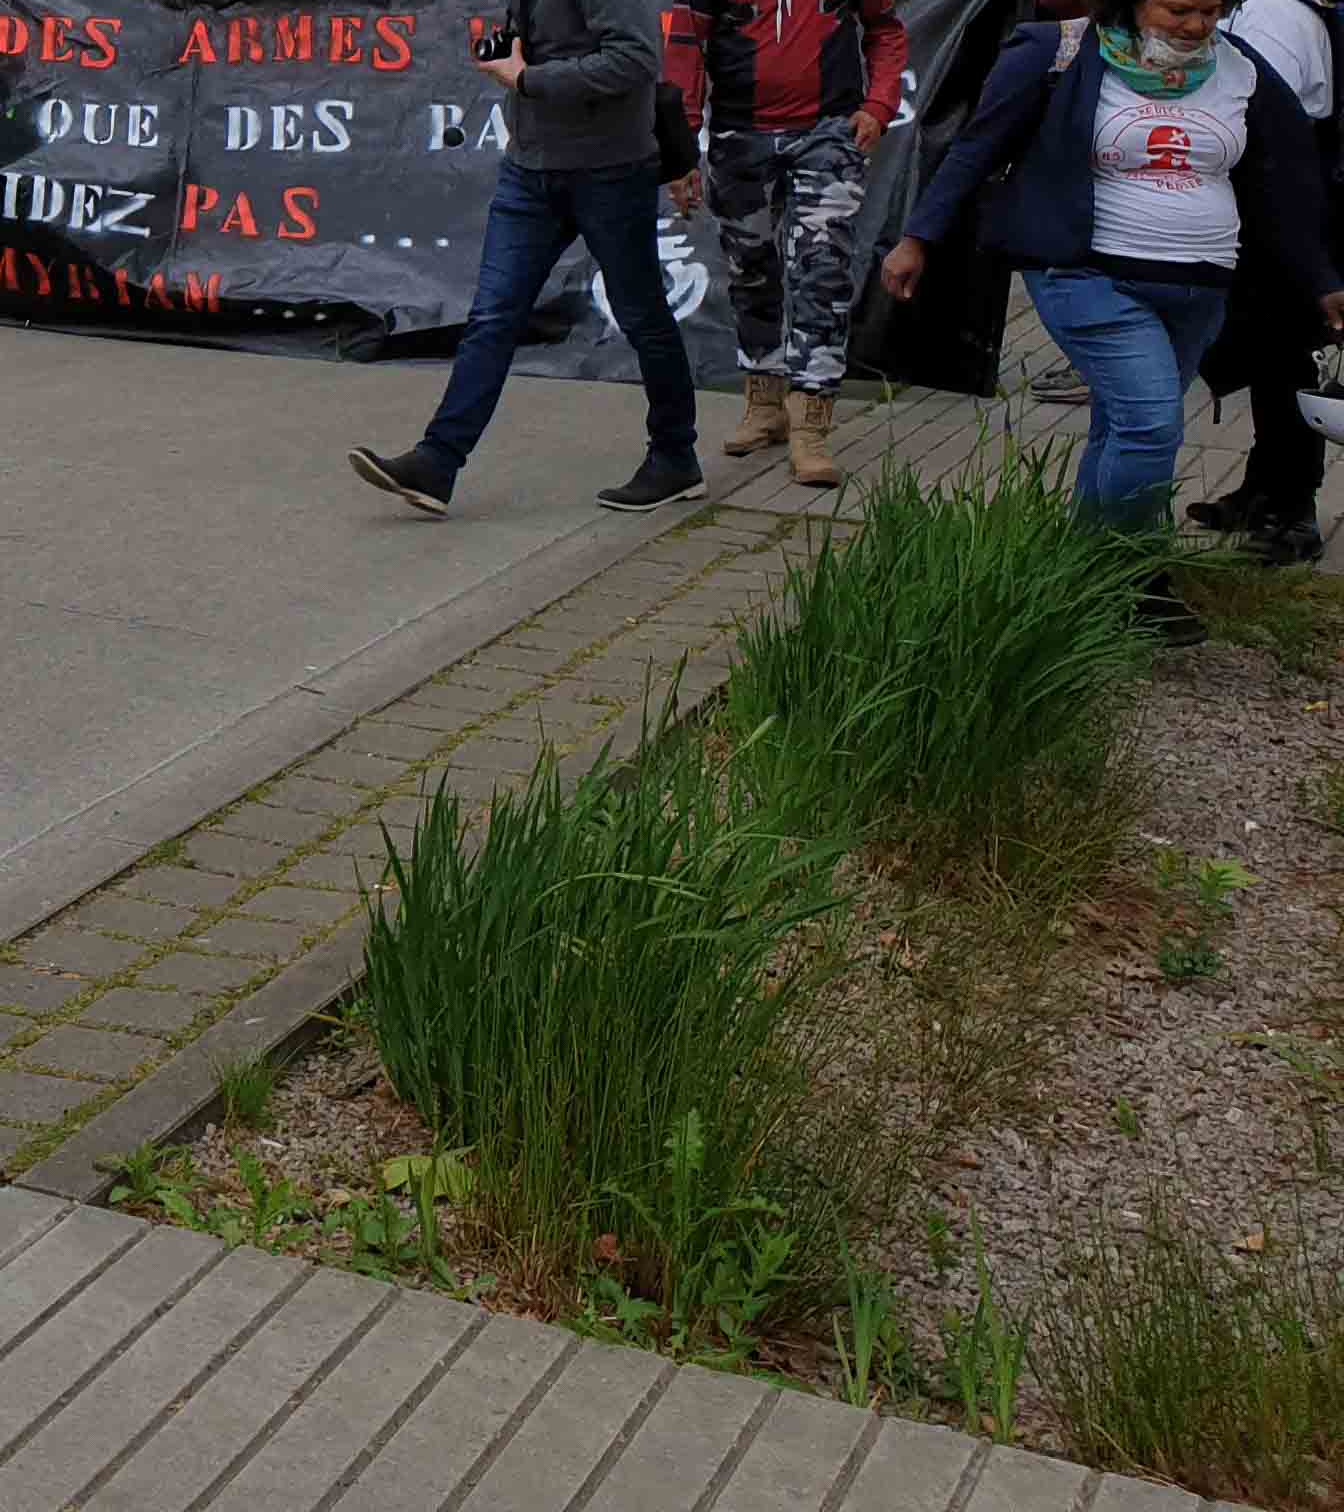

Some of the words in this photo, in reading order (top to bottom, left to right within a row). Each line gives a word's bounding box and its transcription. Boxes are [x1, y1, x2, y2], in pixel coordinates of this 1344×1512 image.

[177, 13, 417, 72] ARMES
[38, 96, 159, 148] QUE
[224, 99, 354, 153] DES
[180, 183, 321, 241] PAS
